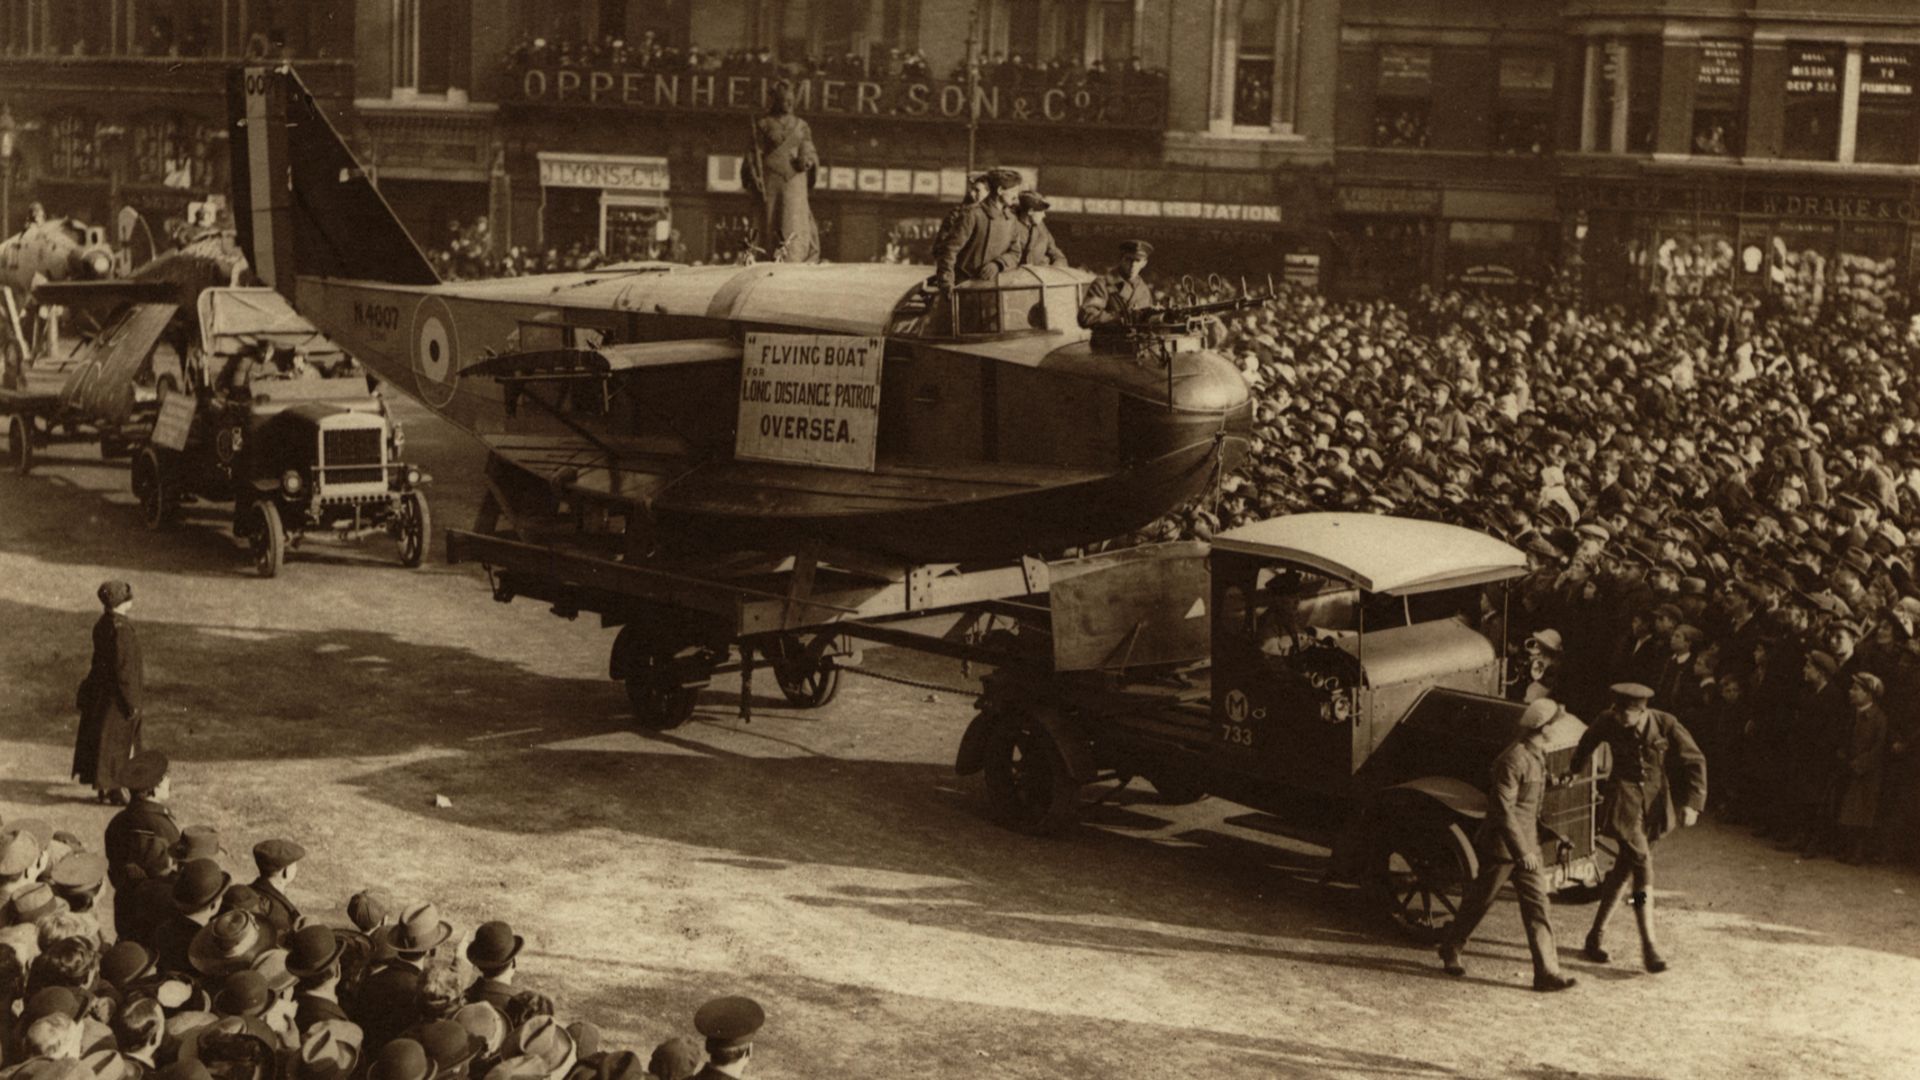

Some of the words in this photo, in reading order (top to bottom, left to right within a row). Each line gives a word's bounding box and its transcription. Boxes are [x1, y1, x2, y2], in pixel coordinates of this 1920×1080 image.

[1880, 67, 1895, 79] TO
[1786, 80, 1814, 92] DEEP
[1816, 81, 1837, 92] SEA
[904, 84, 999, 119] SON
[1012, 97, 1030, 120] &
[559, 163, 622, 186] LYONS
[1787, 195, 1871, 218] DRAKE
[746, 367, 766, 377] FOR
[742, 379, 772, 403] LONG
[774, 380, 832, 407] DISTANCE
[834, 383, 877, 410] PATROL
[760, 413, 856, 444] OVERSEA.
[1222, 723, 1252, 747] 733
